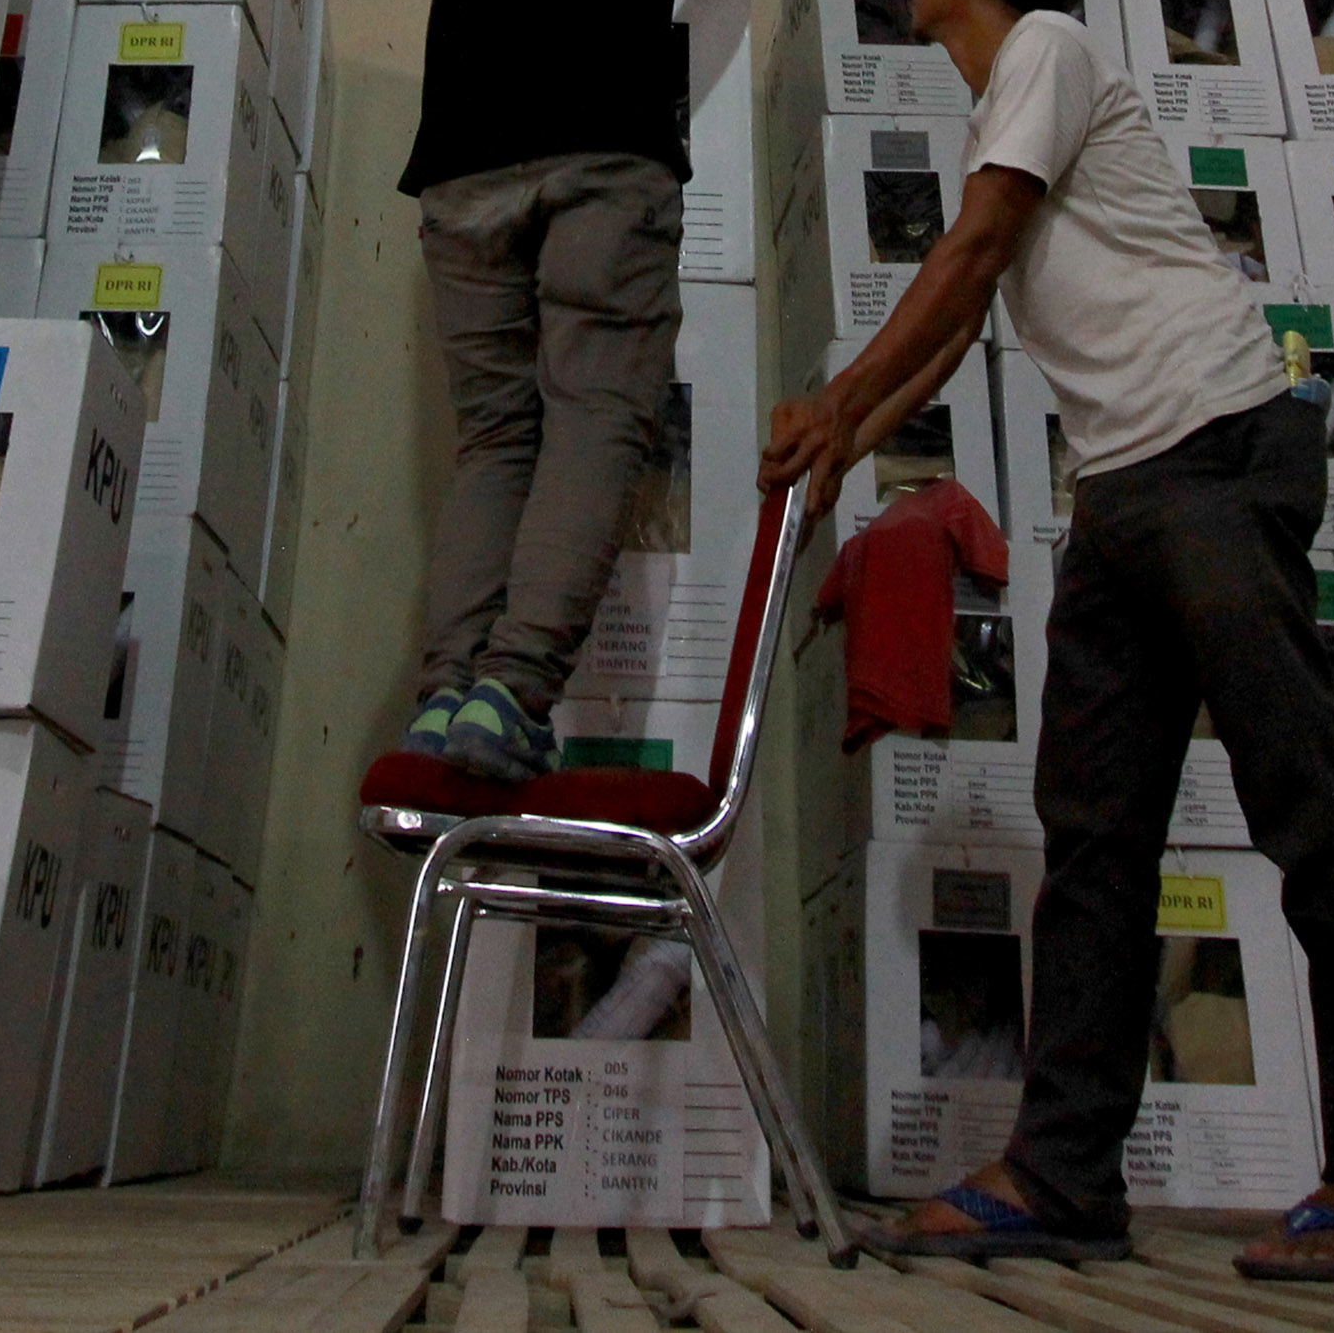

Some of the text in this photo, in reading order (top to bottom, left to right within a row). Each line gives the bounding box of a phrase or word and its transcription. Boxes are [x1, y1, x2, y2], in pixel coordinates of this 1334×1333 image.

[130, 37, 175, 47] DPR RI
[105, 280, 152, 291] DPR RI
[85, 428, 129, 526] KPU
[597, 640, 646, 652] SERANG
[17, 839, 61, 931] KPU
[1160, 895, 1214, 911] DPR RI
[92, 884, 131, 951] KPU
[496, 1062, 628, 1082] Nomor Kotak 005
[495, 1089, 539, 1104] Nomor
[544, 1089, 571, 1104] TPS
[494, 1108, 640, 1127] Nama PPS CIPER
[492, 1130, 662, 1150] Nama PPK CIKANDE
[491, 1153, 657, 1174] Kab./Kota SERANG
[490, 1176, 658, 1196] Provinsi BANTEN
